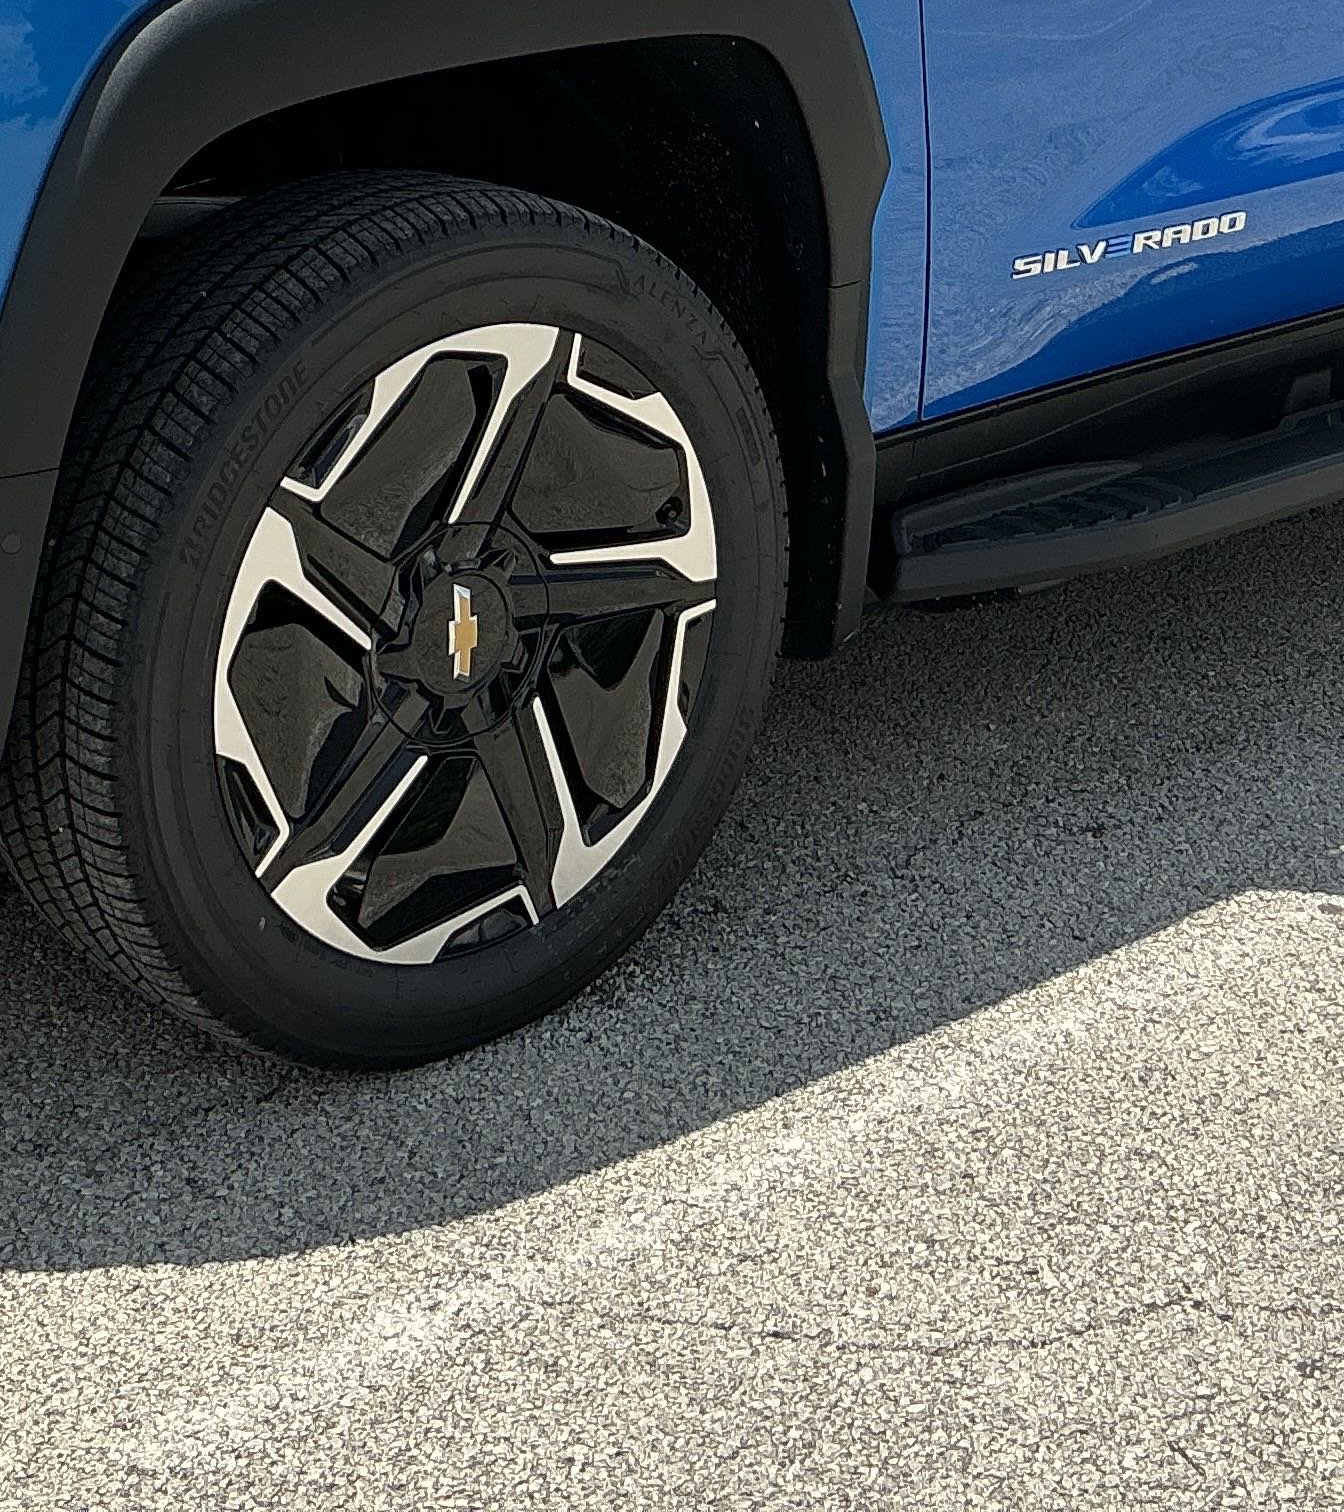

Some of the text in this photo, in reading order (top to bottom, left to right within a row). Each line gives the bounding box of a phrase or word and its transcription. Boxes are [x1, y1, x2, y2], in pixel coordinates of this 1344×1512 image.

[1011, 210, 1248, 280] SILVERADO
[633, 274, 707, 346] ALENZA
[180, 358, 312, 568] BRIDGESTONE
